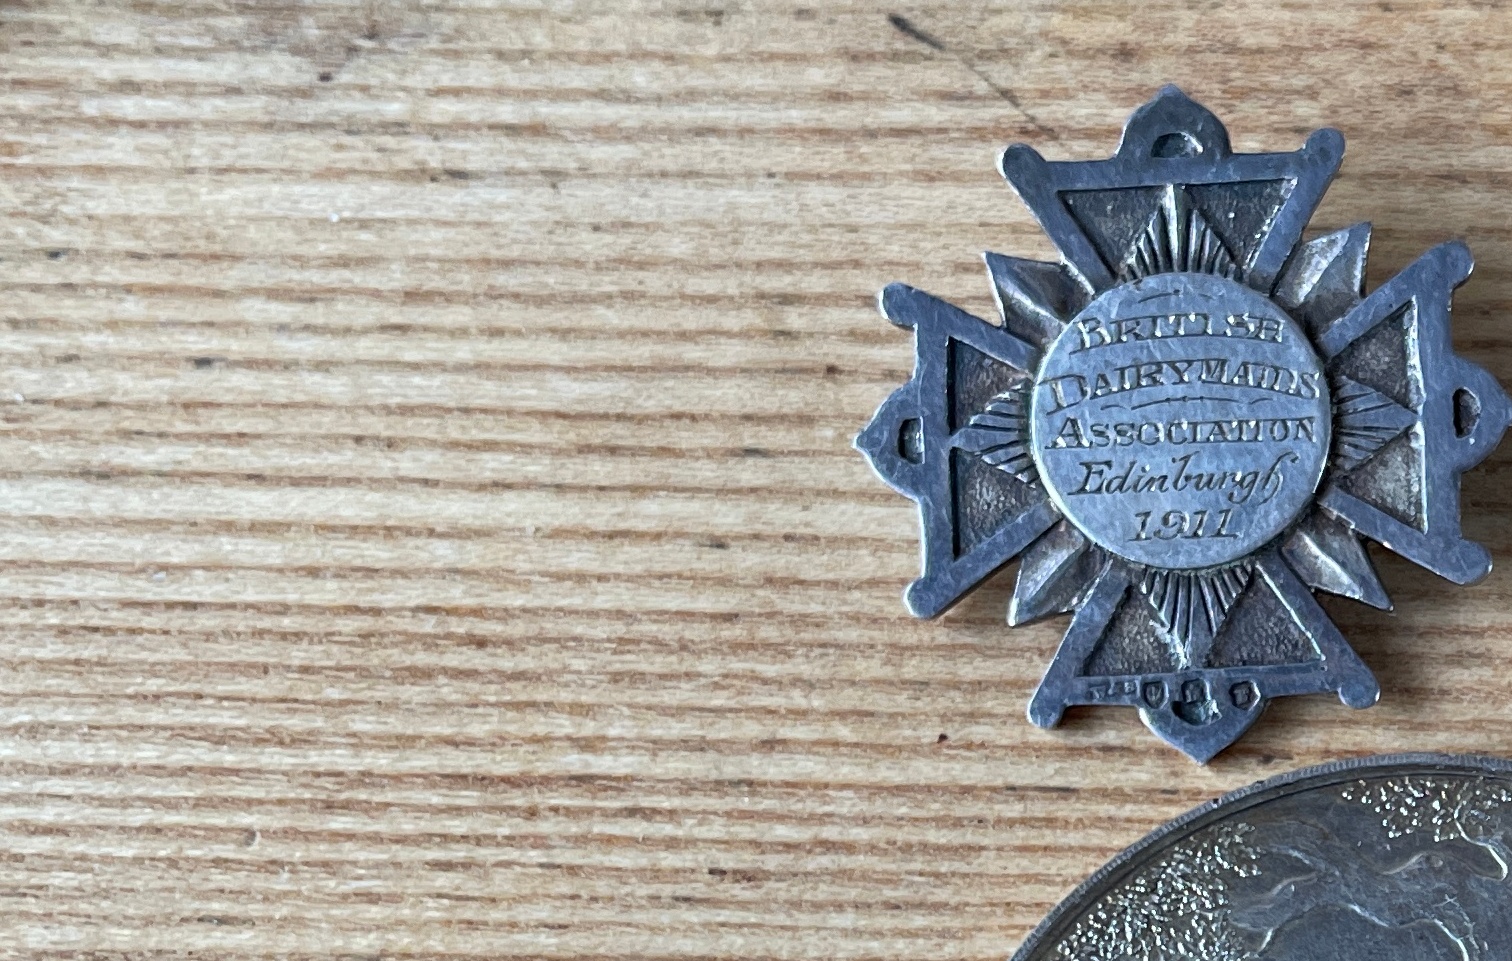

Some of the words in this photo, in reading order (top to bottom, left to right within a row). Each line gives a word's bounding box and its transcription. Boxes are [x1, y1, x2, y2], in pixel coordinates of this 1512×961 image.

[1069, 312, 1285, 355] BRITISH
[1038, 357, 1322, 416] DAIRYMAIDS
[1045, 416, 1317, 450] ASSOCIATION
[1066, 451, 1299, 505] Edinburgh
[1127, 508, 1241, 542] 1911
